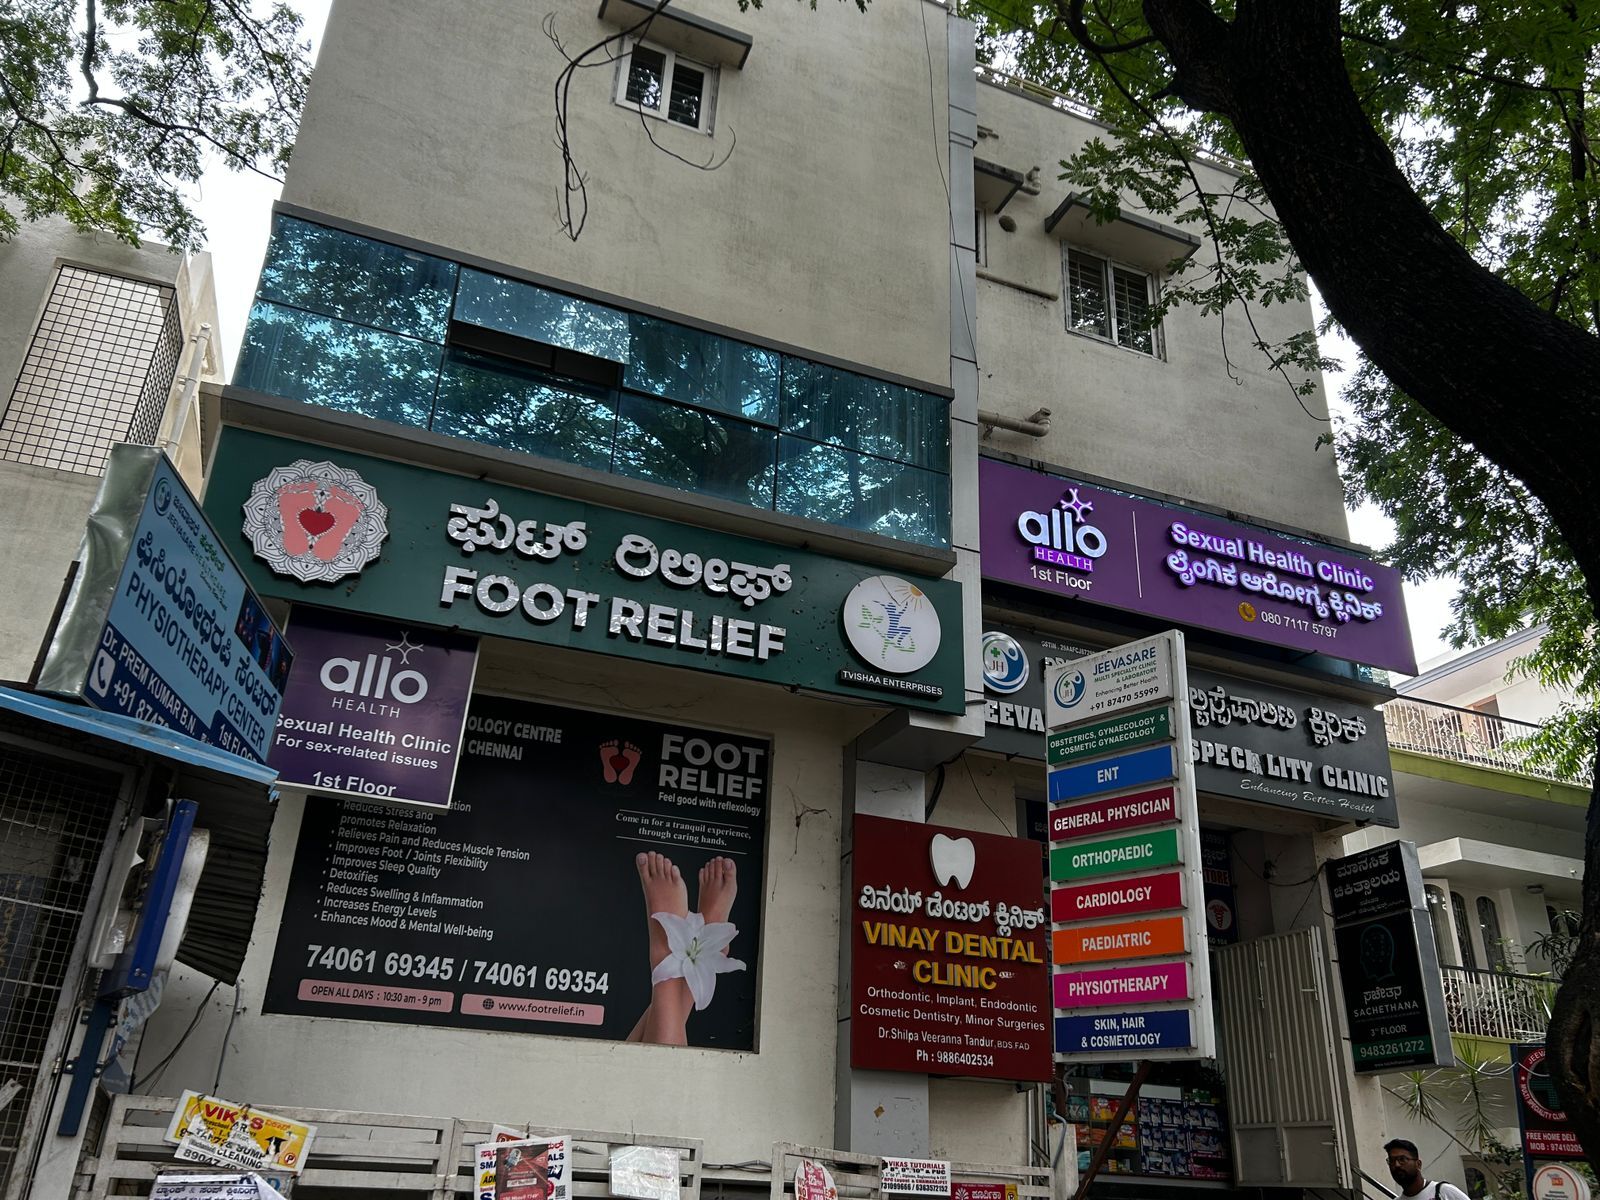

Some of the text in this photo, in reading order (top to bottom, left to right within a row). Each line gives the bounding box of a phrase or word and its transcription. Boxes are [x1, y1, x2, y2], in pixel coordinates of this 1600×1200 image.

[1017, 507, 1108, 559] allo
[447, 497, 793, 607] ಫುಟ್ ರಿಲೀಫ್
[1034, 546, 1093, 572] HEALTH
[1171, 521, 1375, 592] Sexual Health Clinic
[1030, 565, 1093, 591] 1st Floor
[1167, 549, 1238, 586] ಲೈಂಗಿಕ
[1240, 571, 1330, 618] ಆರೋಗ್ಯ
[440, 565, 787, 660] FOOT RELIEF
[1260, 611, 1337, 638] 080 7117 5797
[102, 627, 181, 720] Dr. PREM KUMAR
[125, 571, 265, 751] PHYSIOTHERAPY CENTER
[1092, 646, 1157, 676] JEEVASARE
[320, 653, 428, 704] allo
[842, 670, 943, 696] TVISHAA ENTERPRISES
[1121, 667, 1157, 682] LABORATORY
[113, 679, 136, 713] +91
[1090, 686, 1159, 712] +91 87470 55999
[1095, 684, 1122, 698] Enhancing
[331, 697, 401, 719] HEALTH
[984, 699, 1046, 733] EEVA
[275, 713, 451, 754] Sexual Health Clinic
[464, 714, 562, 744] OLOGY CENTRE
[1050, 716, 1155, 749] OBSTETRICS, GYNAECOLOGY
[1059, 726, 1156, 756] COSMETIC GYNAECOLOGY
[276, 733, 438, 770] For sex-related issues
[468, 739, 523, 761] CHENNAI
[661, 733, 765, 774] FOOT
[312, 771, 397, 797] 1st Floor
[658, 764, 763, 800] RELIEF
[1097, 766, 1119, 783] ENT
[1322, 764, 1389, 798] CLINIC
[658, 791, 762, 817] Feel good with reflexology
[1240, 779, 1375, 814] Enhancing Better Health
[343, 800, 434, 821] Reduces Stress and
[615, 812, 706, 834] Come tranquil
[1054, 811, 1105, 831] GENERAL
[1107, 797, 1170, 822] PHYSICIAN
[340, 814, 437, 835] promotes Relaxation
[638, 826, 727, 847] through caring hands.
[335, 841, 489, 871] Improves Foot Joints Flexibility
[338, 827, 530, 861] Relieves Pain and Reduces Muscle Tension
[1072, 843, 1153, 868] ORTHOPAEDIC
[329, 867, 379, 884] Detoxifies
[332, 855, 441, 878] Improves Sleep Quality
[323, 896, 438, 919] Increases Energy Levels
[326, 881, 484, 910] Reduces Swelling Inflammation
[1076, 886, 1152, 909] CARDIOLOGY
[859, 884, 1045, 937] ವಿನಯ್ ಡೆಂಟಲ್ ಕ್ಲಿನಿಕ್
[320, 910, 494, 941] Enhances Mood Mental Well-being
[862, 920, 1043, 964] VINAY DENTAL
[1082, 931, 1152, 951] PAEDIATRIC
[306, 944, 610, 995] 74061 69345 74061 69354
[913, 959, 997, 990] CLINIC
[311, 984, 403, 1003] OPEN ALL DAYS 10:30
[1069, 975, 1169, 997] PHYSIOTHERAPY
[498, 1000, 586, 1018] www.footrelief.in
[867, 986, 1038, 1013] Orthodontic, Implant, Endodontic
[1354, 1000, 1419, 1018] SACHETHANA
[859, 1004, 1045, 1032] Cosmetic Dentistry, Minor Surgeries
[1094, 1016, 1145, 1031] SKIN, HAIR
[1380, 1024, 1408, 1036] FLOOR
[921, 1030, 962, 1045] Veeranna
[1090, 1033, 1161, 1047] COSMETOLOGY
[1360, 1040, 1425, 1058] 9483261272
[937, 1050, 994, 1067] 9886402534
[1526, 1132, 1561, 1141] FREE HOME
[217, 1148, 262, 1169] CLEANING
[889, 1160, 908, 1168] VIKAS
